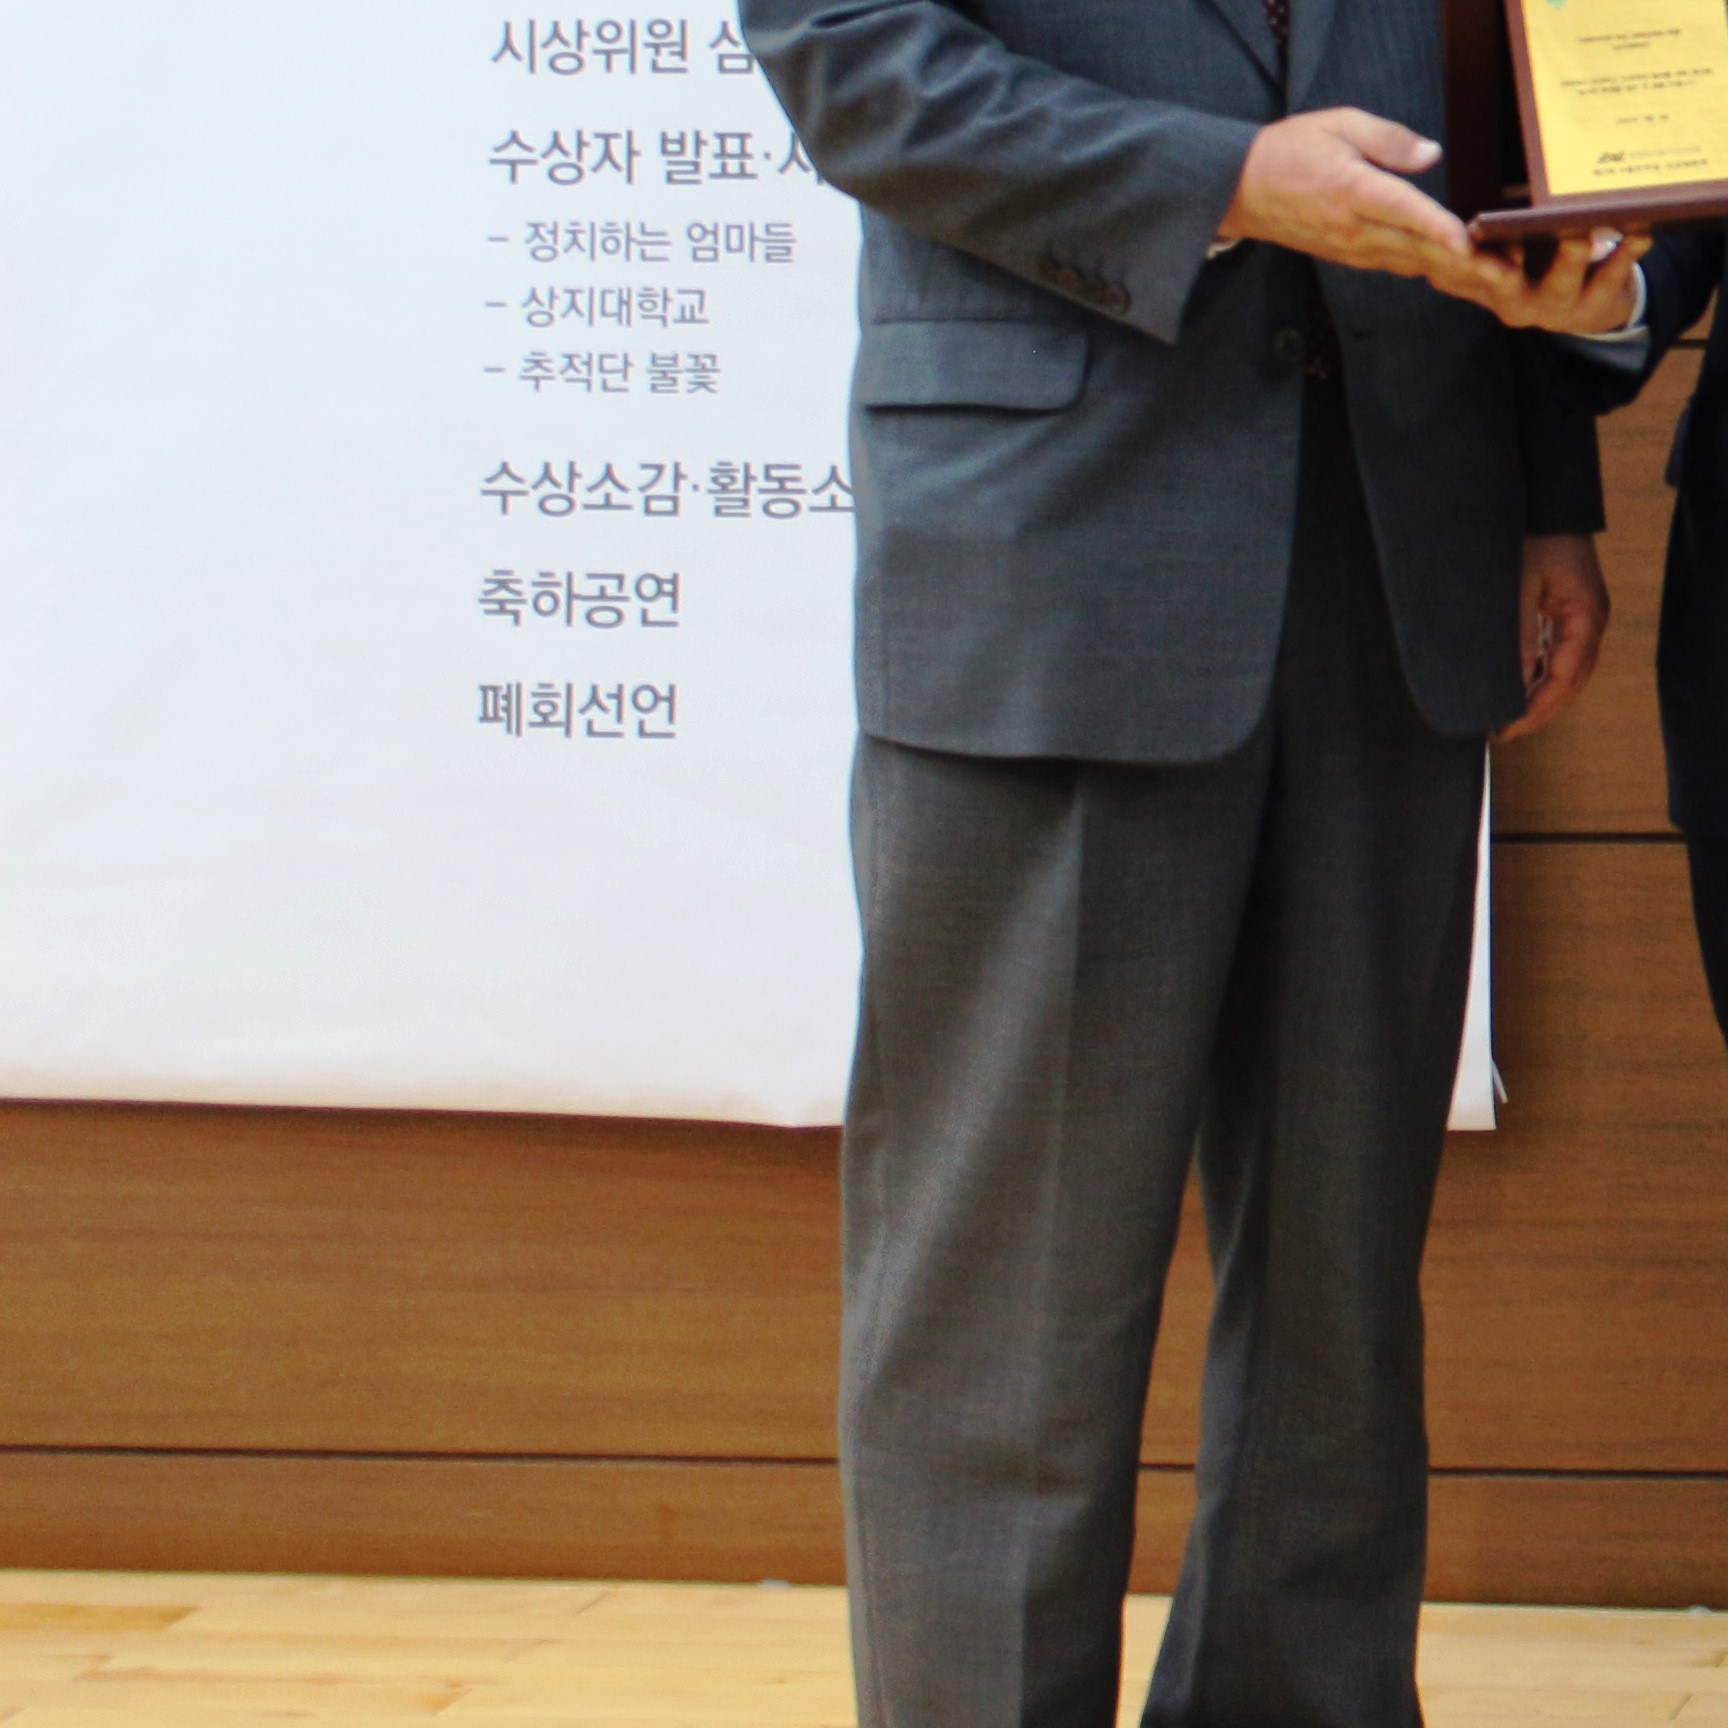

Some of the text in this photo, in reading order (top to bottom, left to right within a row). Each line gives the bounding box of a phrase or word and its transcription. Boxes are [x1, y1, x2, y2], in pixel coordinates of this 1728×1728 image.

[490, 18, 755, 76] 시상위원 심
[488, 129, 641, 186] 수상자
[524, 220, 672, 263] 정치하는
[686, 221, 797, 264] 엄마들
[521, 286, 710, 328] 상지대학교
[518, 351, 634, 393] 추적단
[646, 352, 721, 394] 불꽃
[477, 569, 681, 629] 축하공연
[477, 681, 677, 739] 폐회선언
